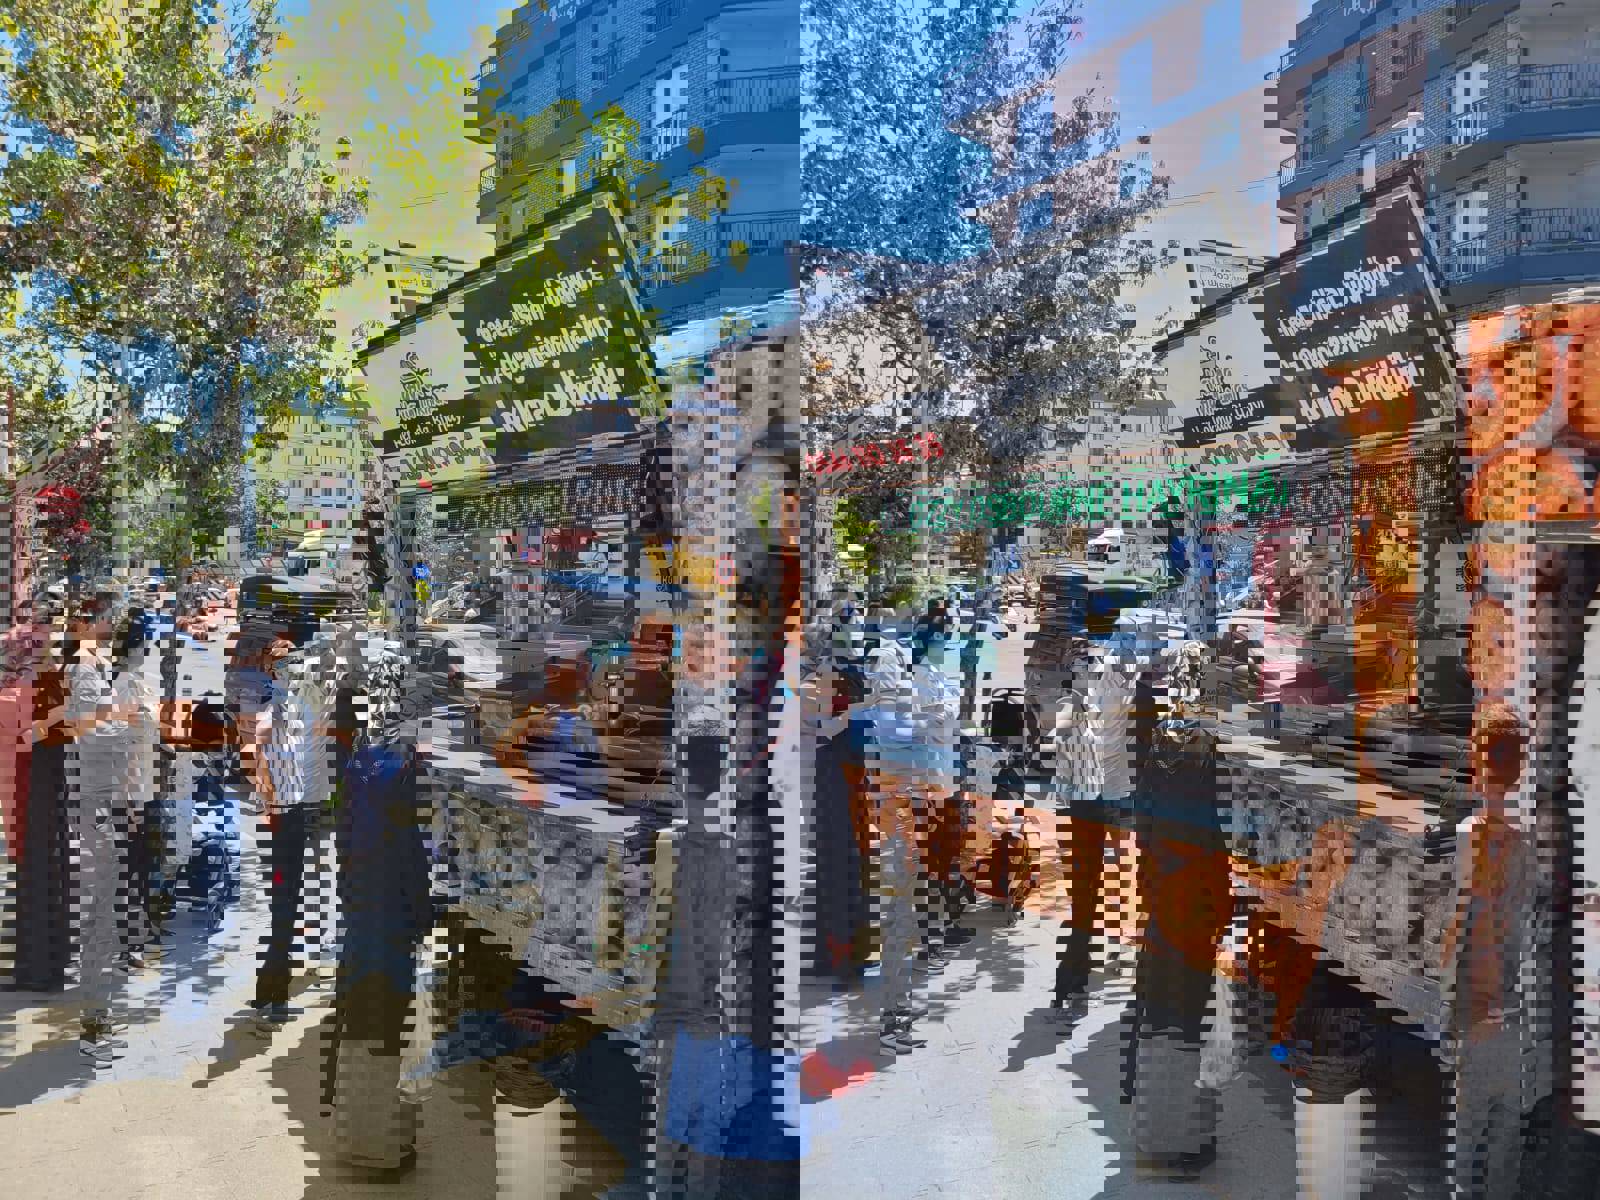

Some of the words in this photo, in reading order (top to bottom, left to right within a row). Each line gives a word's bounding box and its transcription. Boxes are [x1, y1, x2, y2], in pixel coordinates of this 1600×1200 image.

[955, 309, 1027, 343] Cenaze,
[1021, 291, 1090, 326] Nişan,
[1085, 263, 1163, 309] Düğün
[1162, 259, 1197, 288] ve
[968, 350, 1015, 383] Özel
[1011, 314, 1172, 377] Organizasyonlar
[1170, 301, 1222, 344] için
[804, 365, 858, 400] Hayrat
[991, 390, 1099, 431] Lokma
[1095, 353, 1243, 414] Dökülür
[791, 427, 812, 444] Her
[812, 416, 864, 439] Lokmada
[862, 410, 882, 429] Bir
[804, 447, 855, 477] 0546
[850, 441, 887, 469] 110
[884, 436, 915, 465] 35
[913, 430, 945, 461] 35
[35, 498, 81, 508] ECZANE
[42, 507, 77, 516] OPTİK
[43, 515, 72, 524] ÇINAR
[909, 495, 964, 529] OZZY
[970, 481, 1115, 526] OSBOURNE
